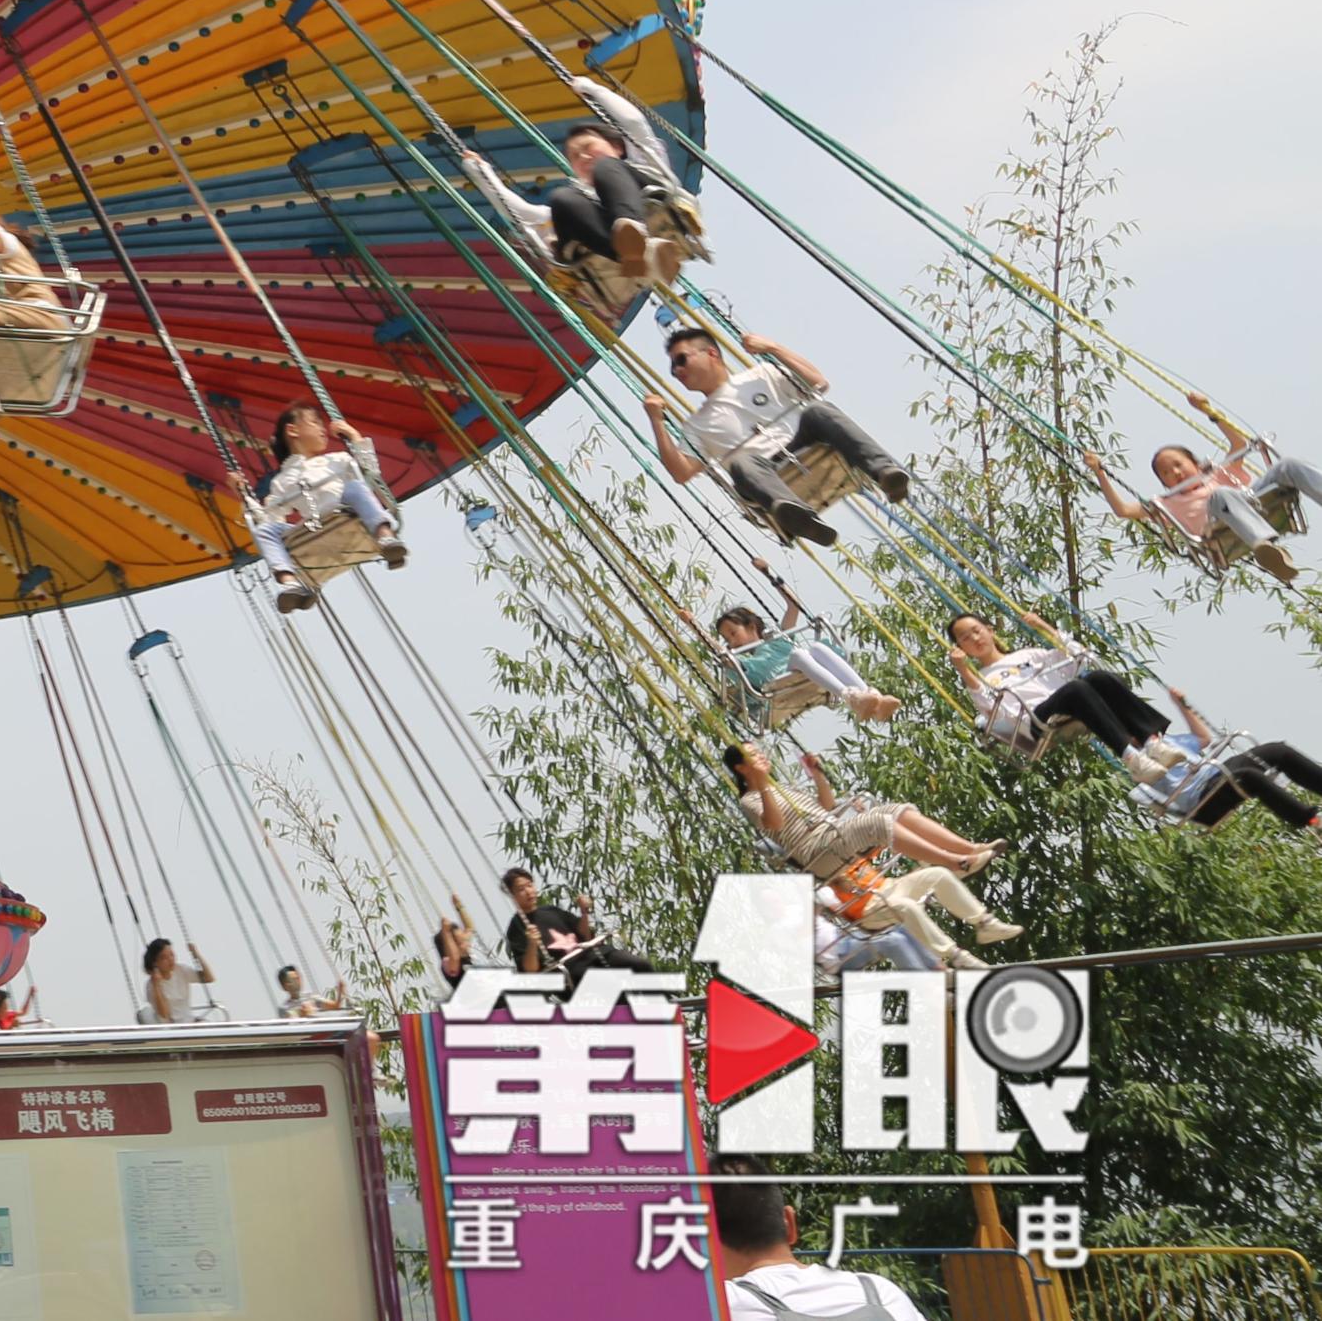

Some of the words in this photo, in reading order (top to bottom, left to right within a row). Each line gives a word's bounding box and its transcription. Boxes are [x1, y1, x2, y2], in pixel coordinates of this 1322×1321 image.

[21, 1089, 107, 1107] 特种设备名称
[17, 1107, 115, 1134] 飓风飞椅
